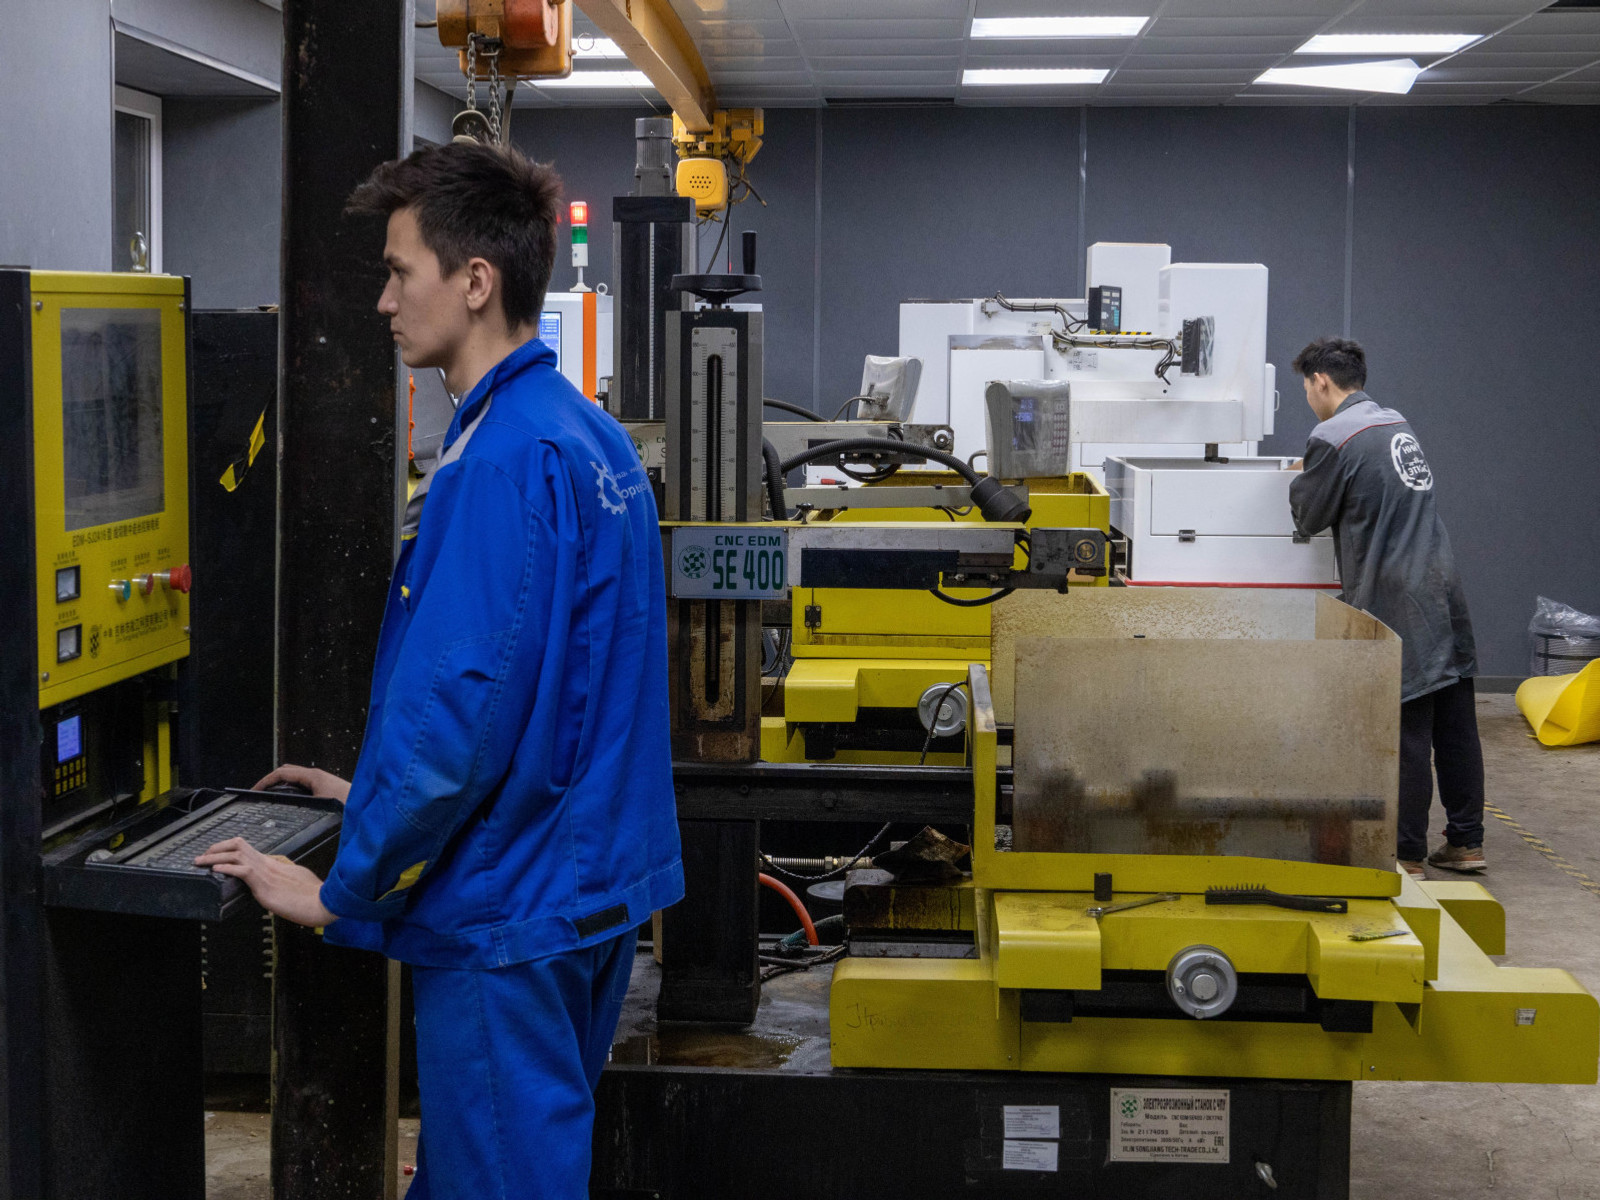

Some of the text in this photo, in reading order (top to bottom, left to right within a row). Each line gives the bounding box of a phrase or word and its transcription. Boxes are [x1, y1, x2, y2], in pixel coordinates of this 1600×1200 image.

[715, 535, 781, 546] CNC EDM
[713, 549, 784, 590] SE 400
